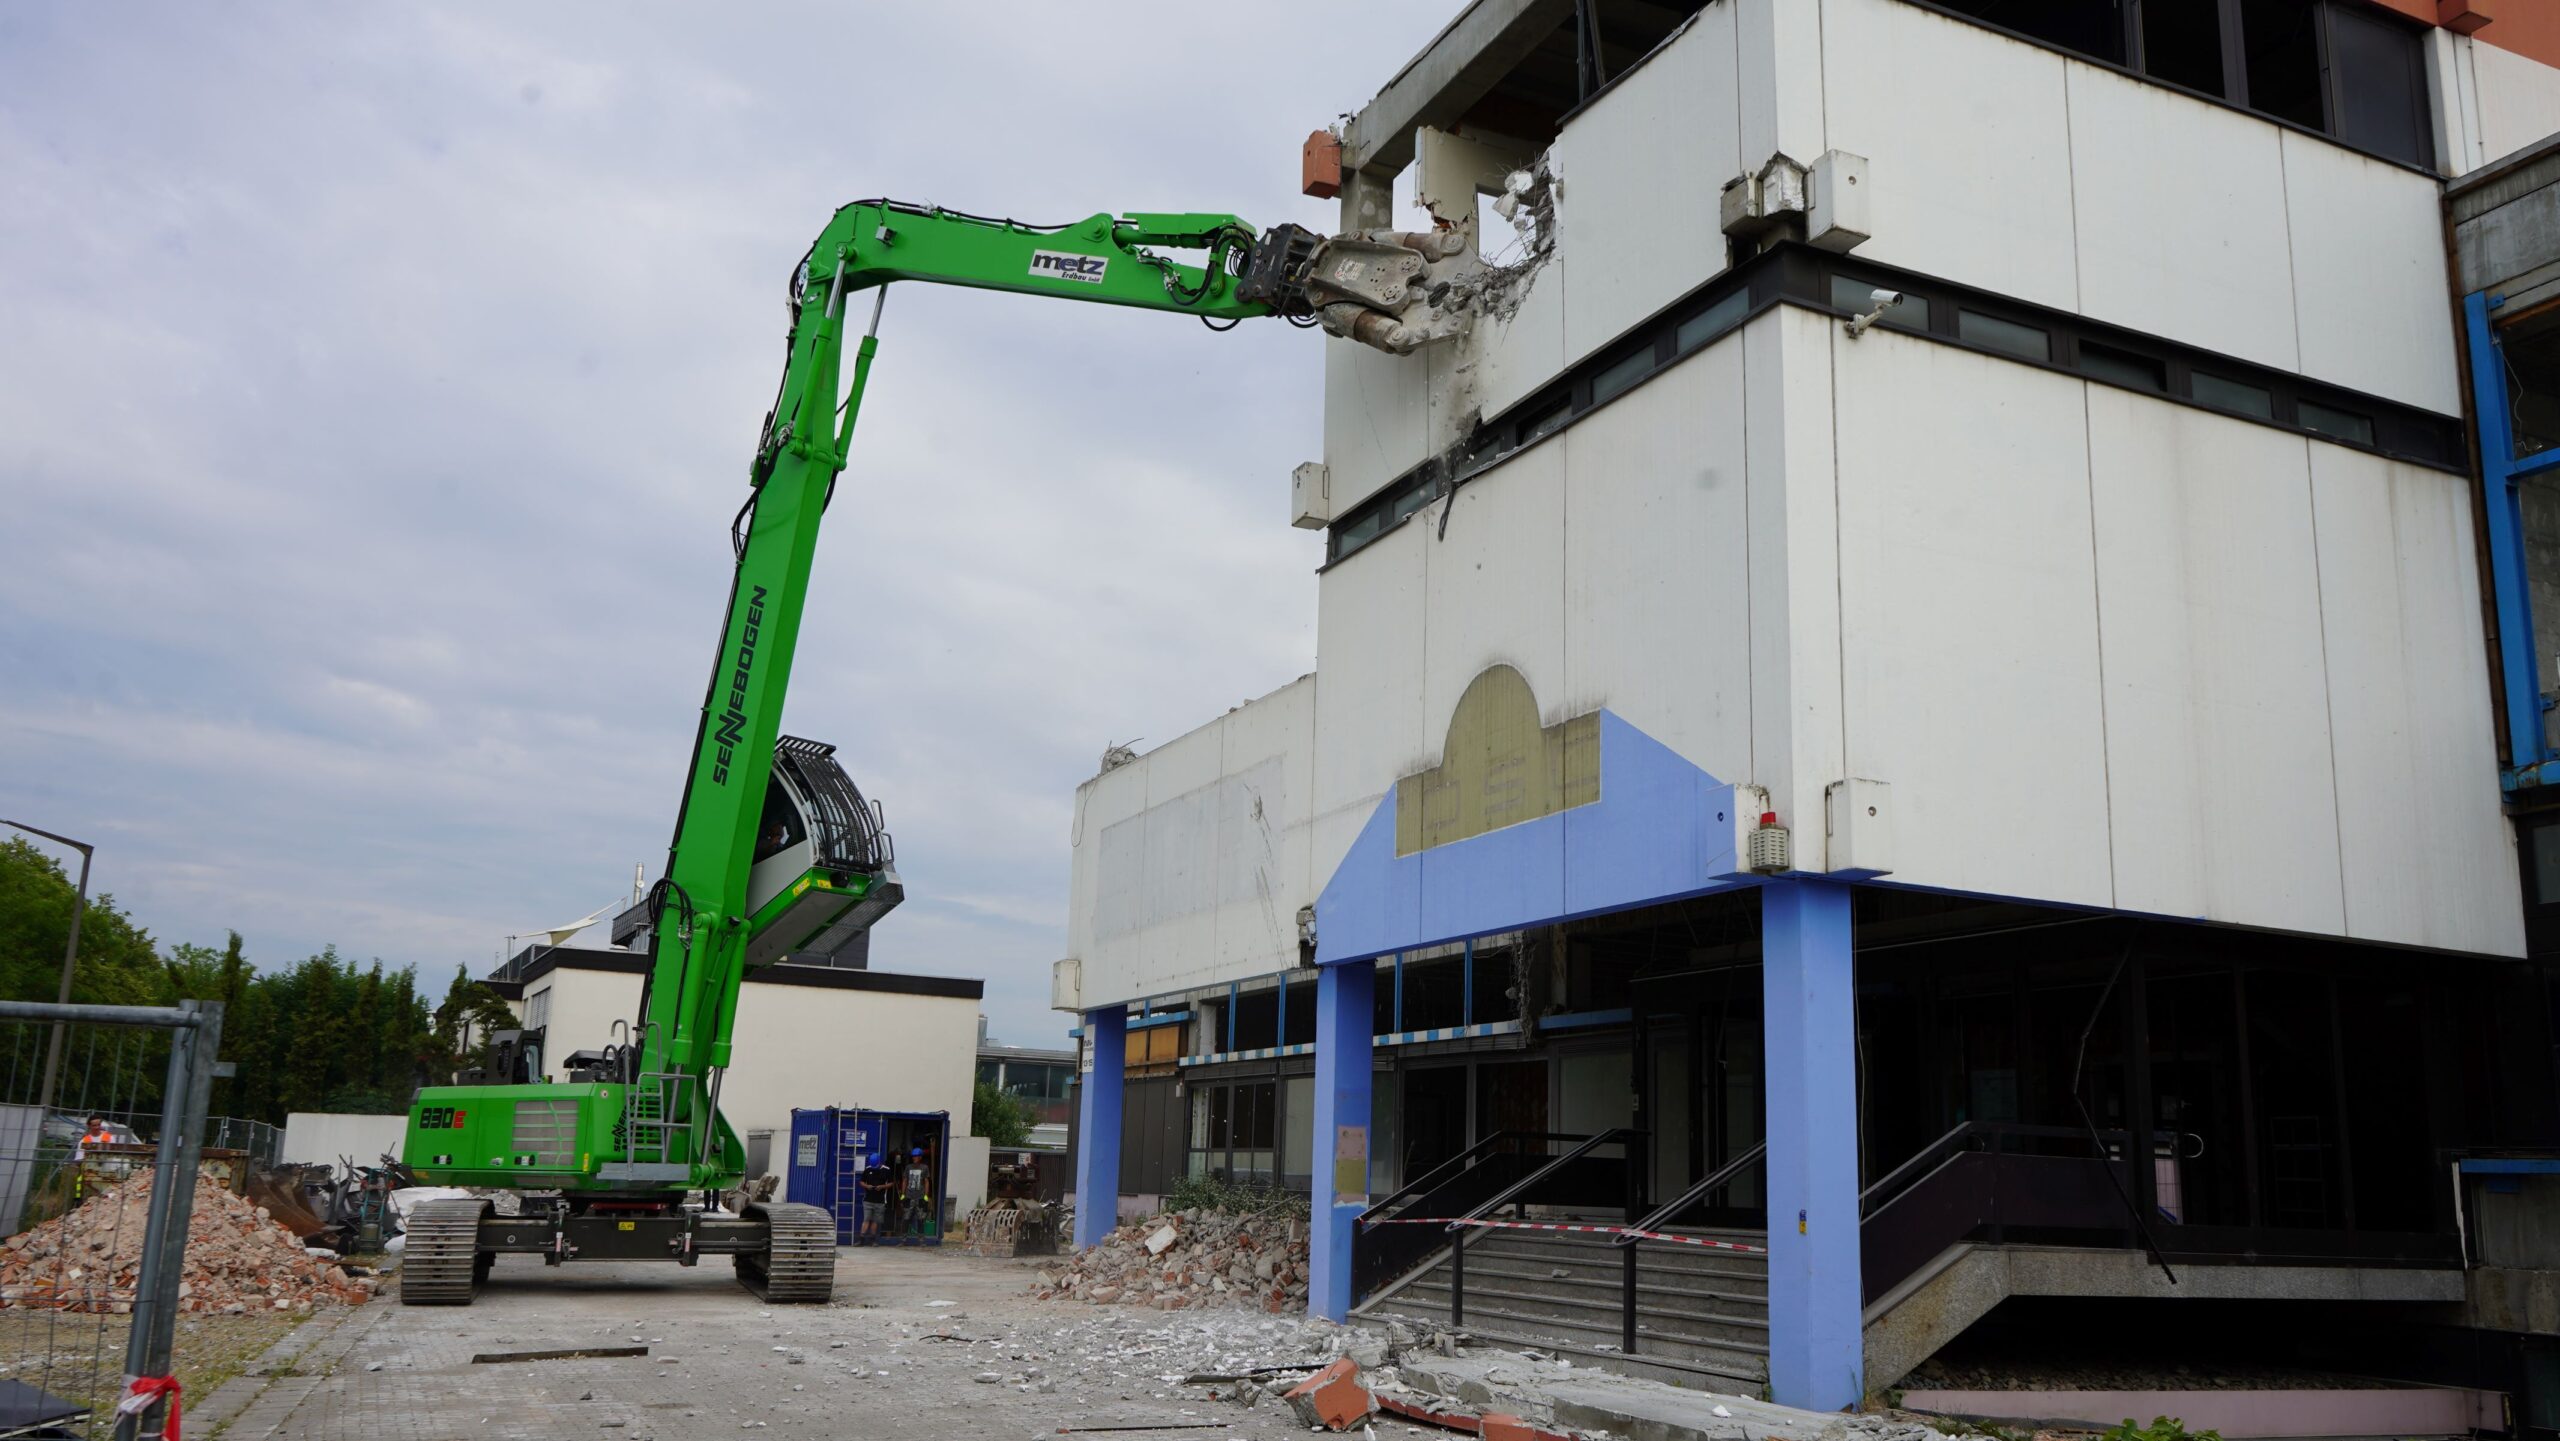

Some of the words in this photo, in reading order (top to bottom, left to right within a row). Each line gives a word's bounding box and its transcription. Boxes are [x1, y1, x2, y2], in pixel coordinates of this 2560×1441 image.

[1032, 254, 1105, 275] metz
[1061, 271, 1087, 281] Erdbau
[712, 584, 768, 787] SENNEBOGEN
[419, 1107, 467, 1129] 830E
